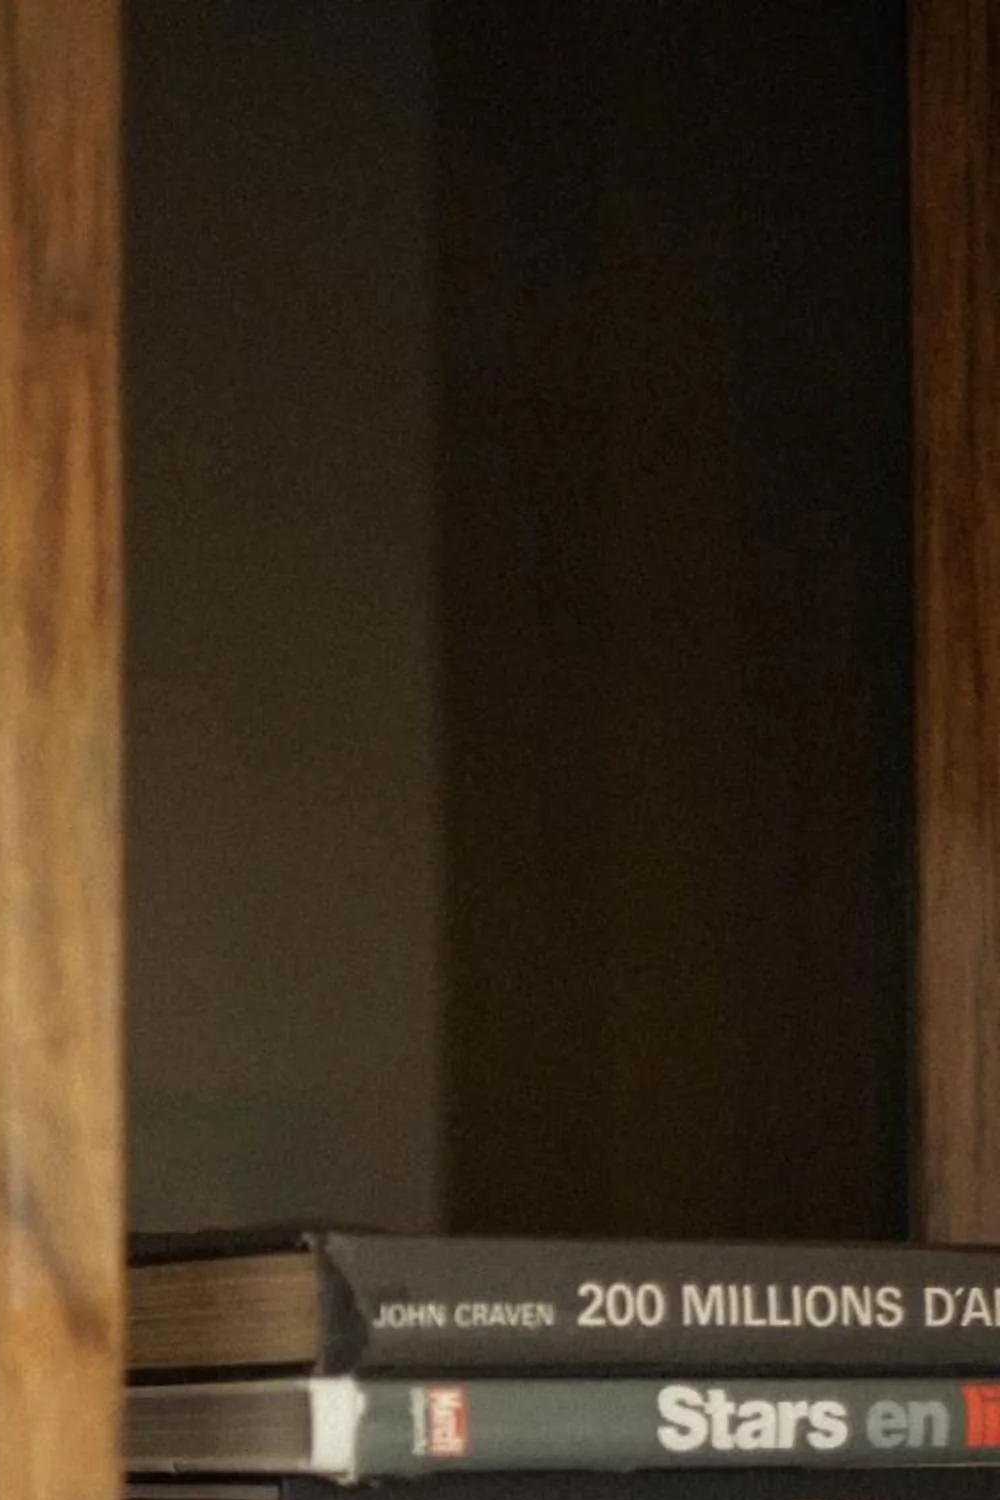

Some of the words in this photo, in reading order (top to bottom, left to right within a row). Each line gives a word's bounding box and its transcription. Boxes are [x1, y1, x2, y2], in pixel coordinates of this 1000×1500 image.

[373, 1303, 447, 1328] JOHN
[454, 1302, 555, 1328] CRAVEN
[576, 1282, 664, 1327] 200
[682, 1284, 903, 1328] MILLIONS
[656, 1385, 849, 1453] Stars
[866, 1396, 950, 1449] en
